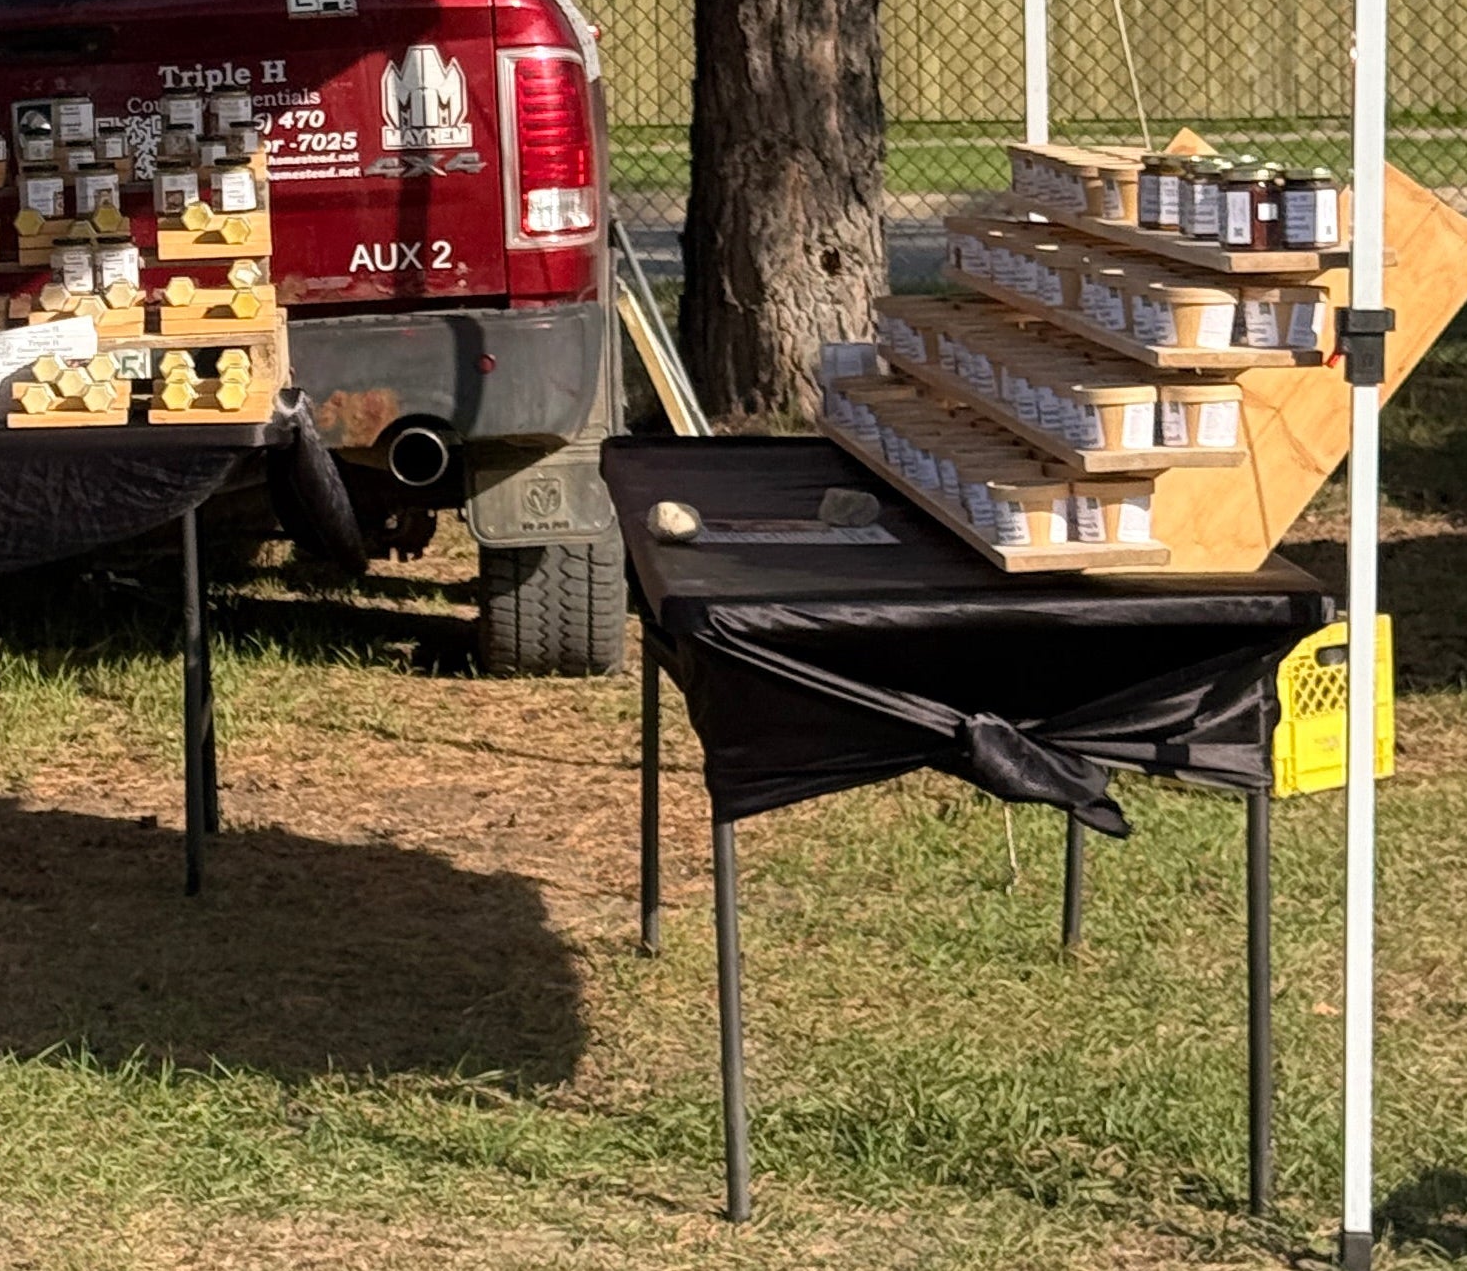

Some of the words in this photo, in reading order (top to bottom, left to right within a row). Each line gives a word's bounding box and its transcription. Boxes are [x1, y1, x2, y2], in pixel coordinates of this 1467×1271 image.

[157, 62, 252, 92] Triple
[259, 59, 288, 84] H
[277, 109, 326, 130] 470
[384, 126, 471, 147] MAYHEM
[349, 241, 423, 273] AUX
[430, 241, 452, 270] 2
